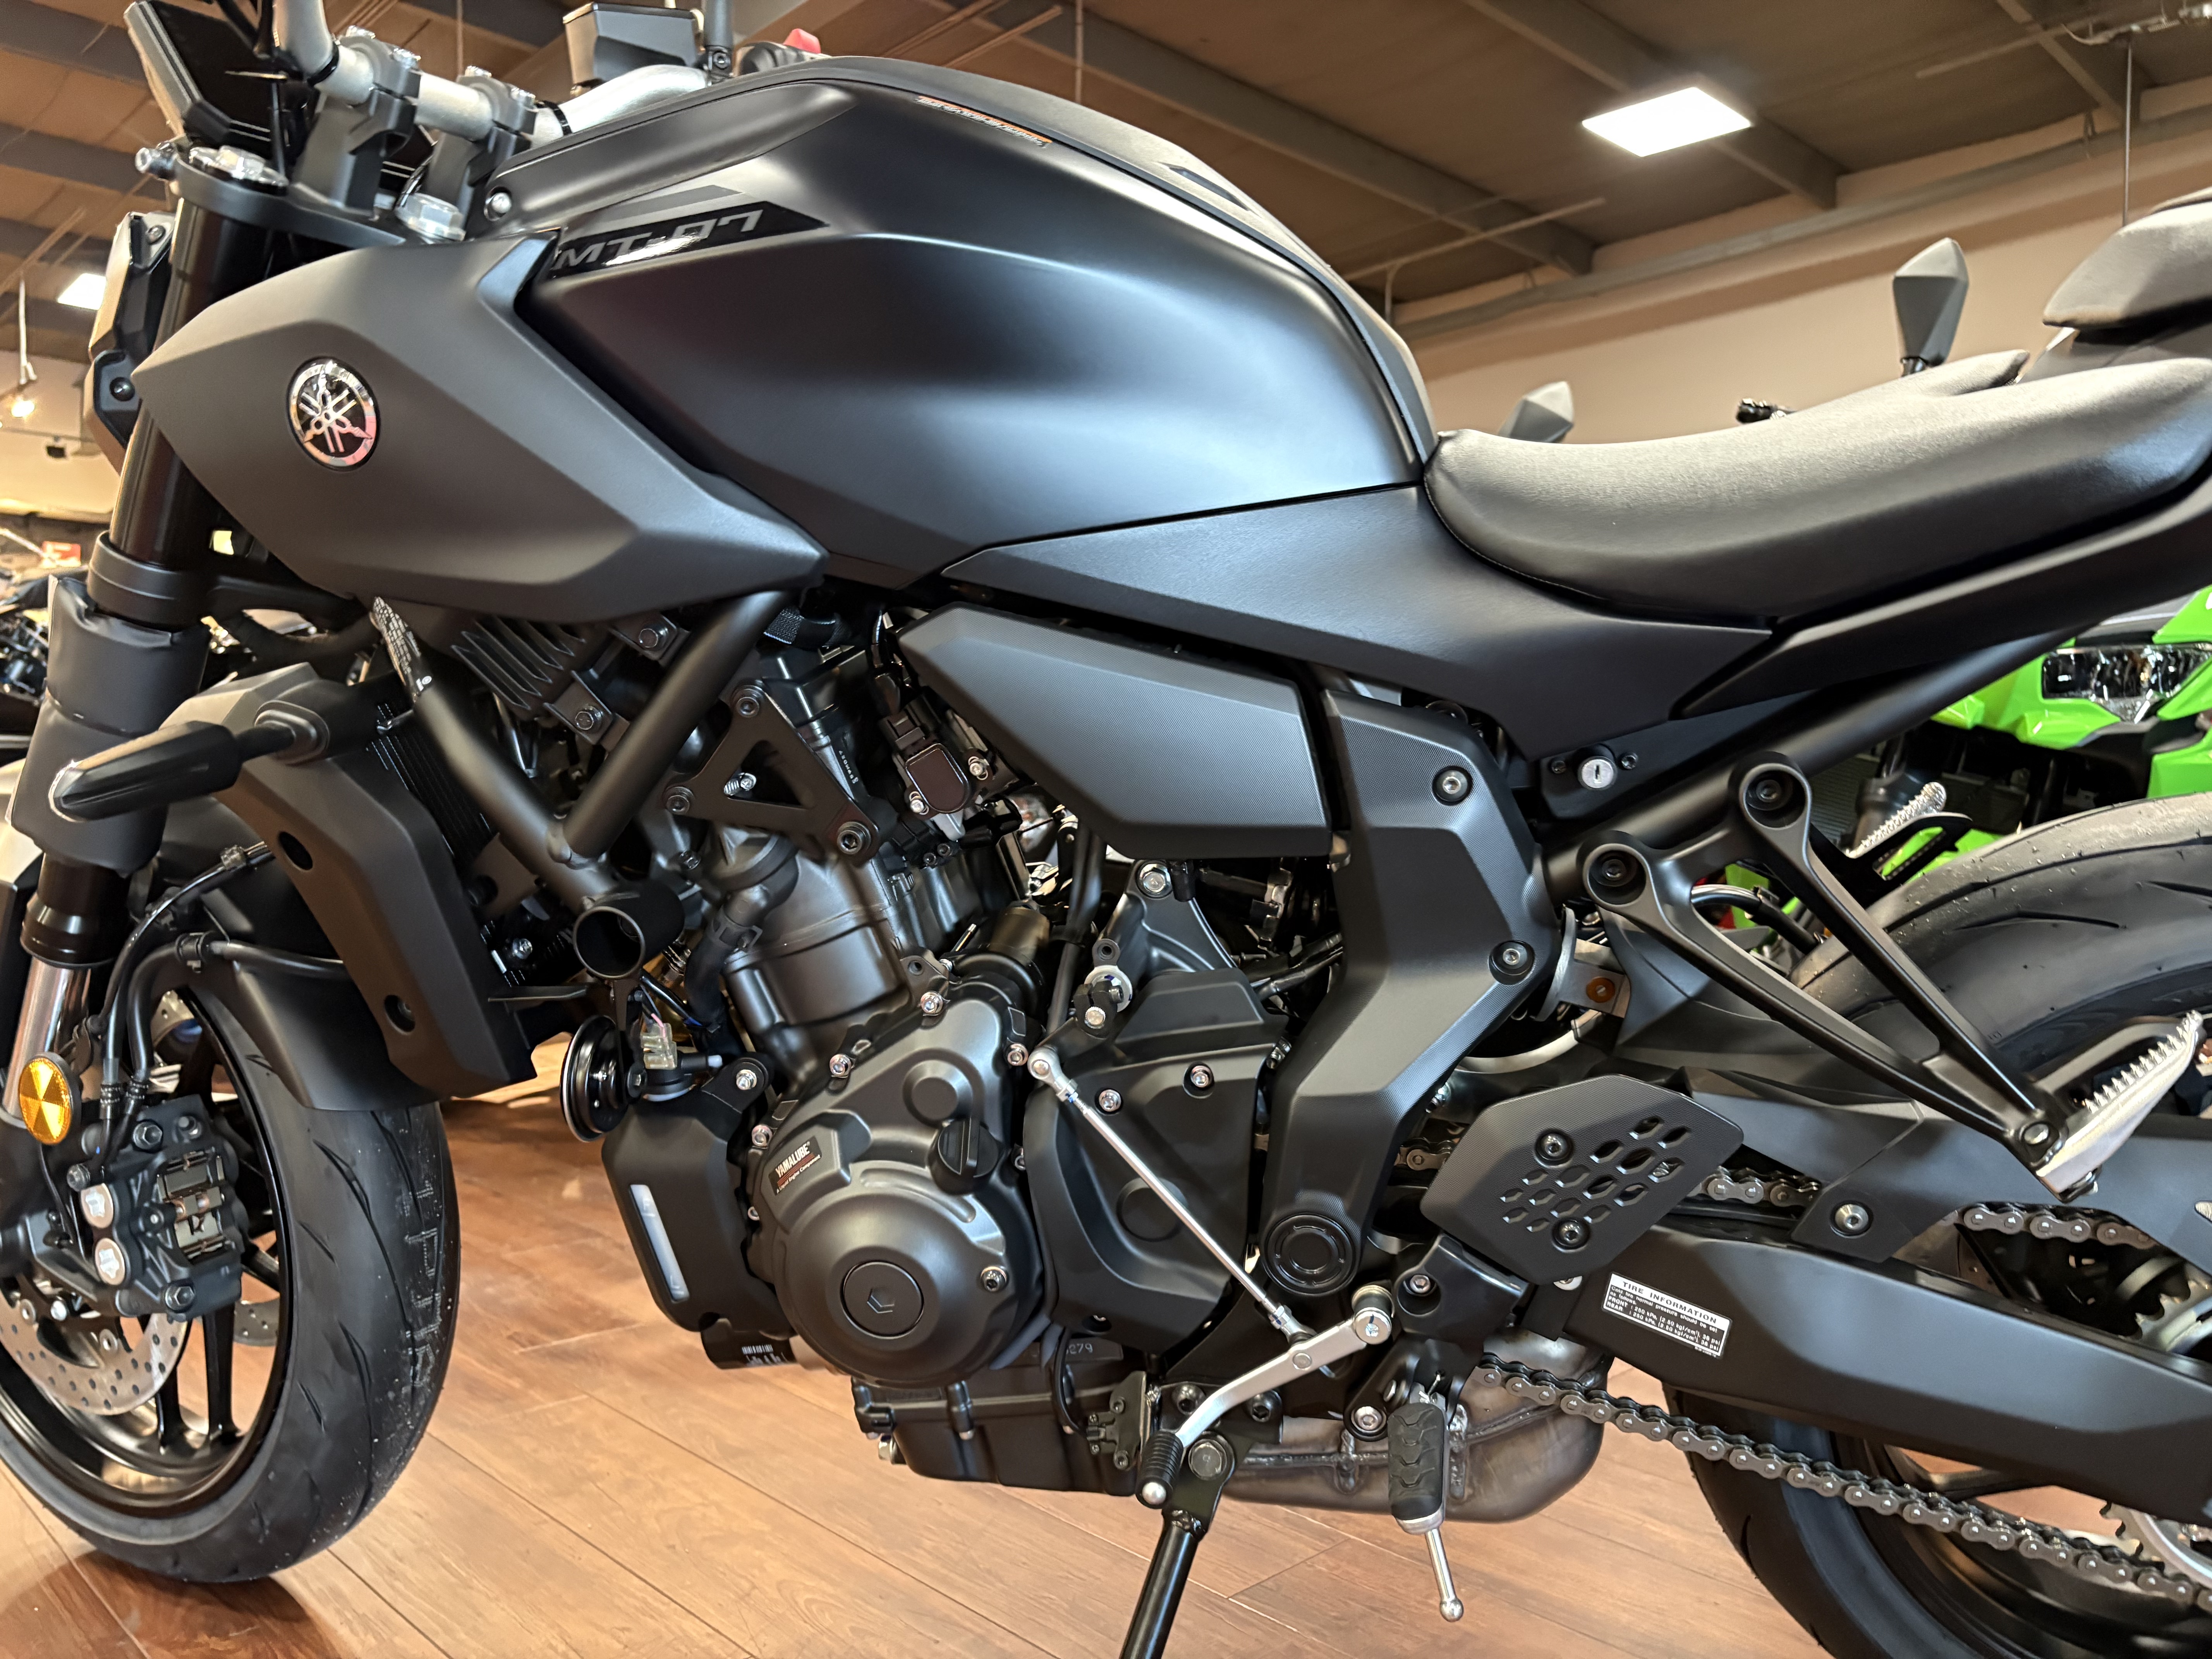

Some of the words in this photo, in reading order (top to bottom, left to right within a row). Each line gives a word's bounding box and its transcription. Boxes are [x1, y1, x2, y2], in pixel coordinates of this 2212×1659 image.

[554, 209, 763, 270] MT-07
[1622, 1281, 1644, 1294] TIRE
[1649, 1292, 1717, 1323] INFORMATION
